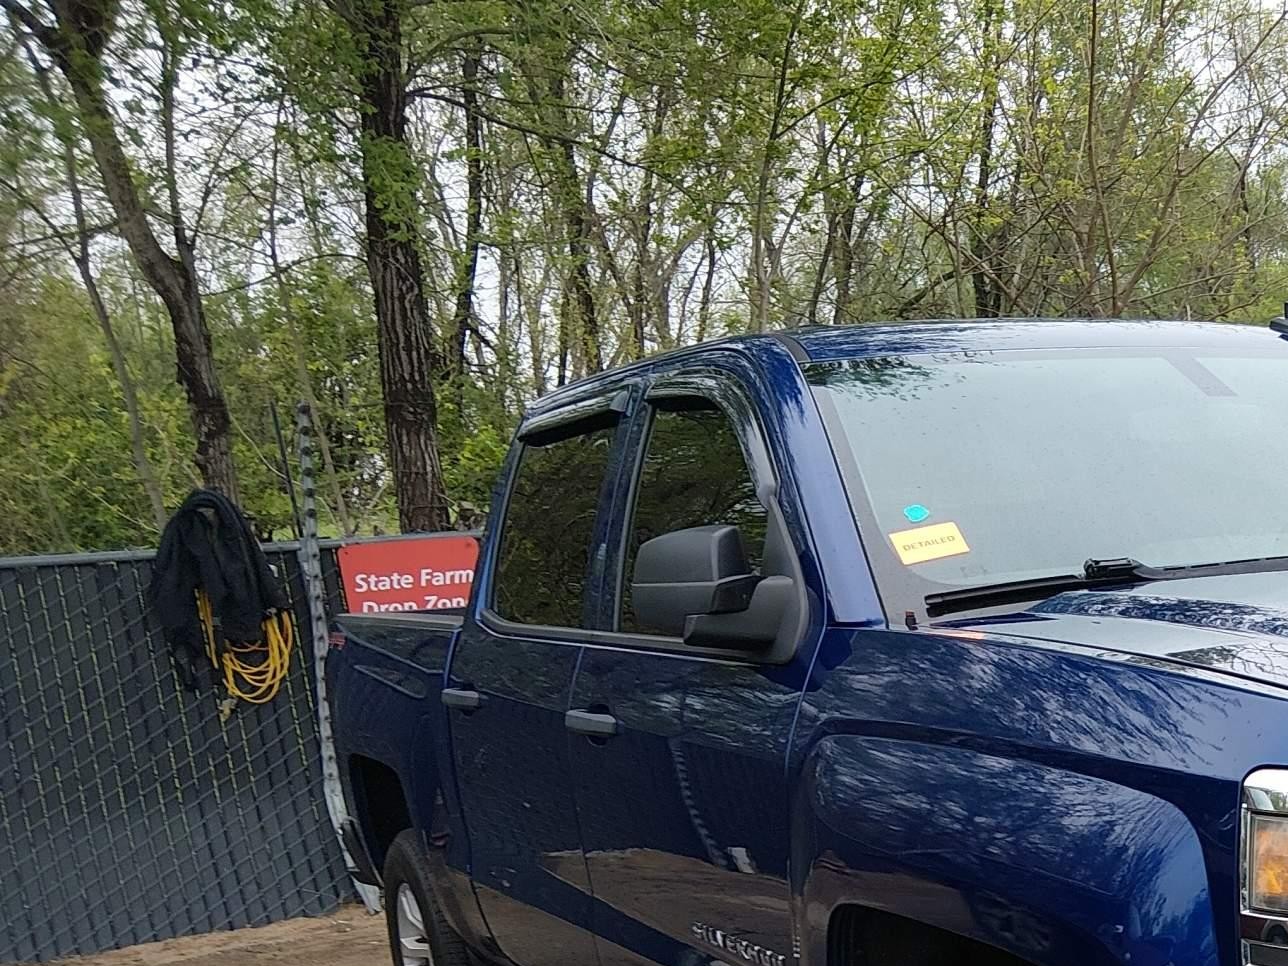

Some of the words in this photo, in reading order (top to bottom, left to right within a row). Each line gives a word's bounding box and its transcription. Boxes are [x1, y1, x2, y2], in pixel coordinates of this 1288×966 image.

[902, 535, 956, 551] DETAILED
[354, 571, 415, 593] State
[420, 568, 473, 587] Farm
[423, 595, 468, 610] Zon
